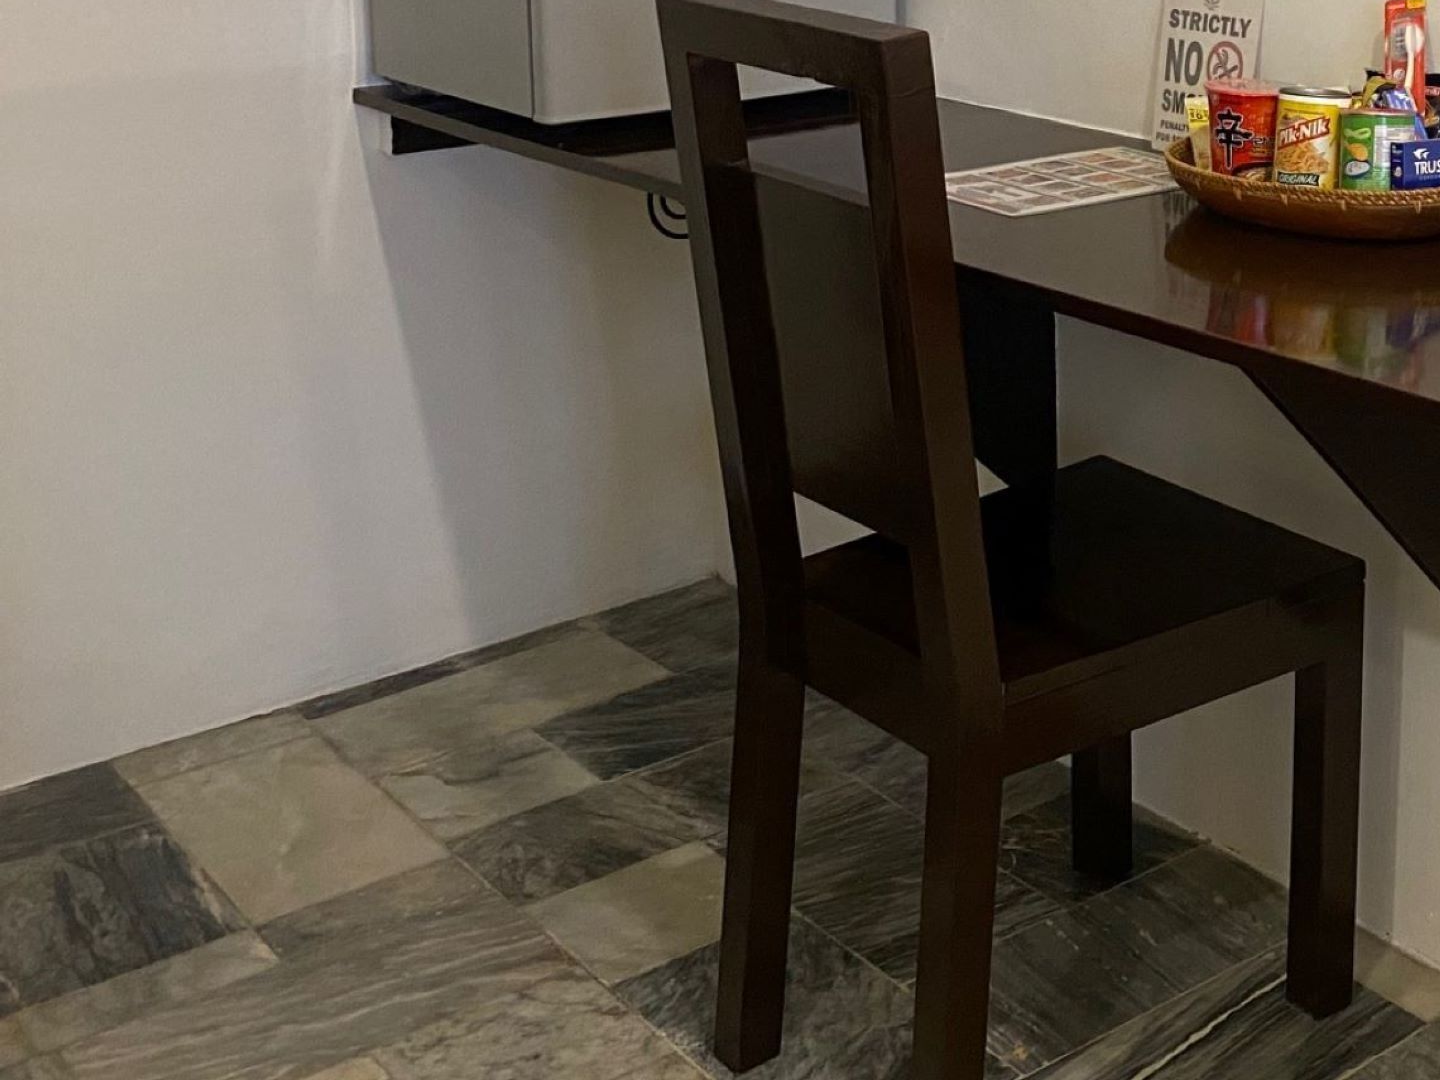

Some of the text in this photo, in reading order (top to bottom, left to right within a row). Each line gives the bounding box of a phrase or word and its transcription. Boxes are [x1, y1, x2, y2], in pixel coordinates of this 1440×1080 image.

[1169, 9, 1252, 38] STRICTLY
[1165, 38, 1203, 86] NO
[1214, 108, 1254, 169] 辛
[1279, 174, 1317, 185] ORIGINAL
